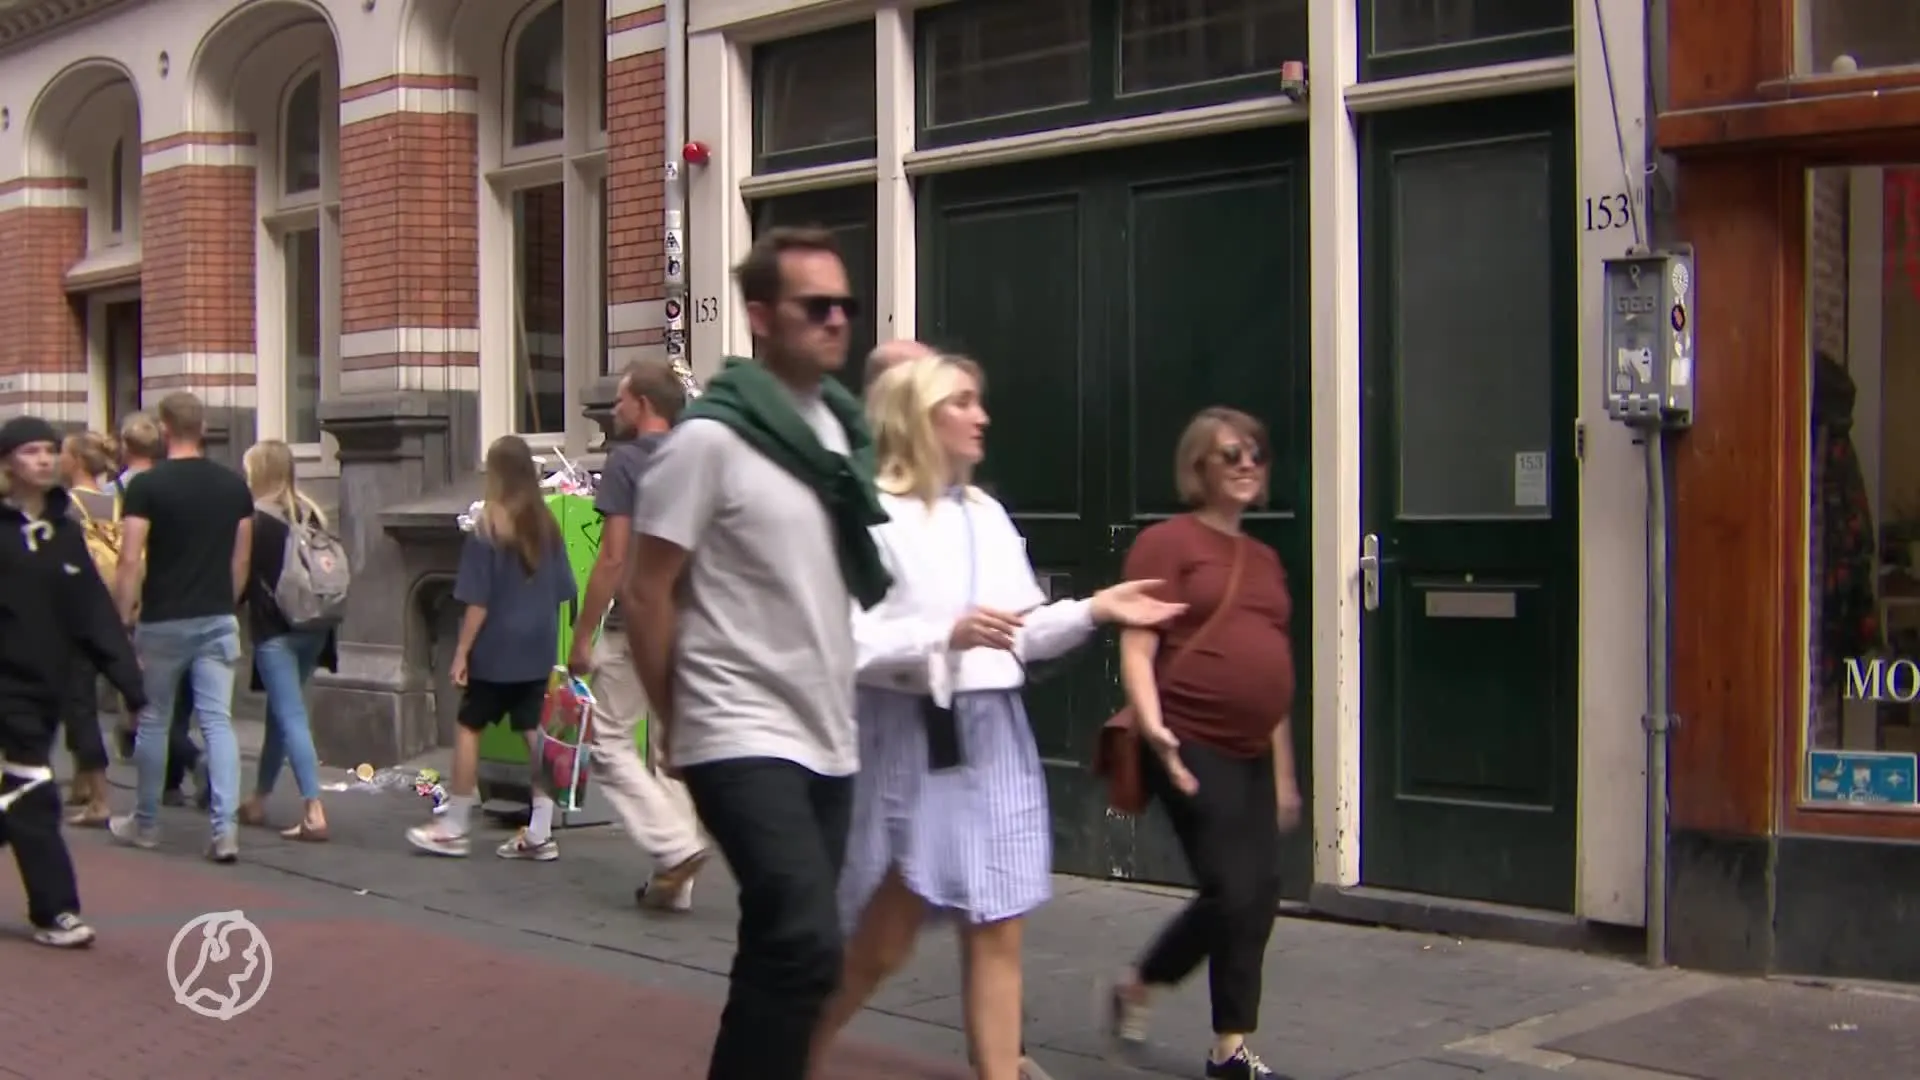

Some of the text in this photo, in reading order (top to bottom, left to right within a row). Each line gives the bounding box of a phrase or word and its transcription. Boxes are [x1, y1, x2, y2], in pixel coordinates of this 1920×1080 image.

[1585, 193, 1630, 231] 153
[695, 296, 718, 324] 153
[1843, 657, 1920, 702] MO
